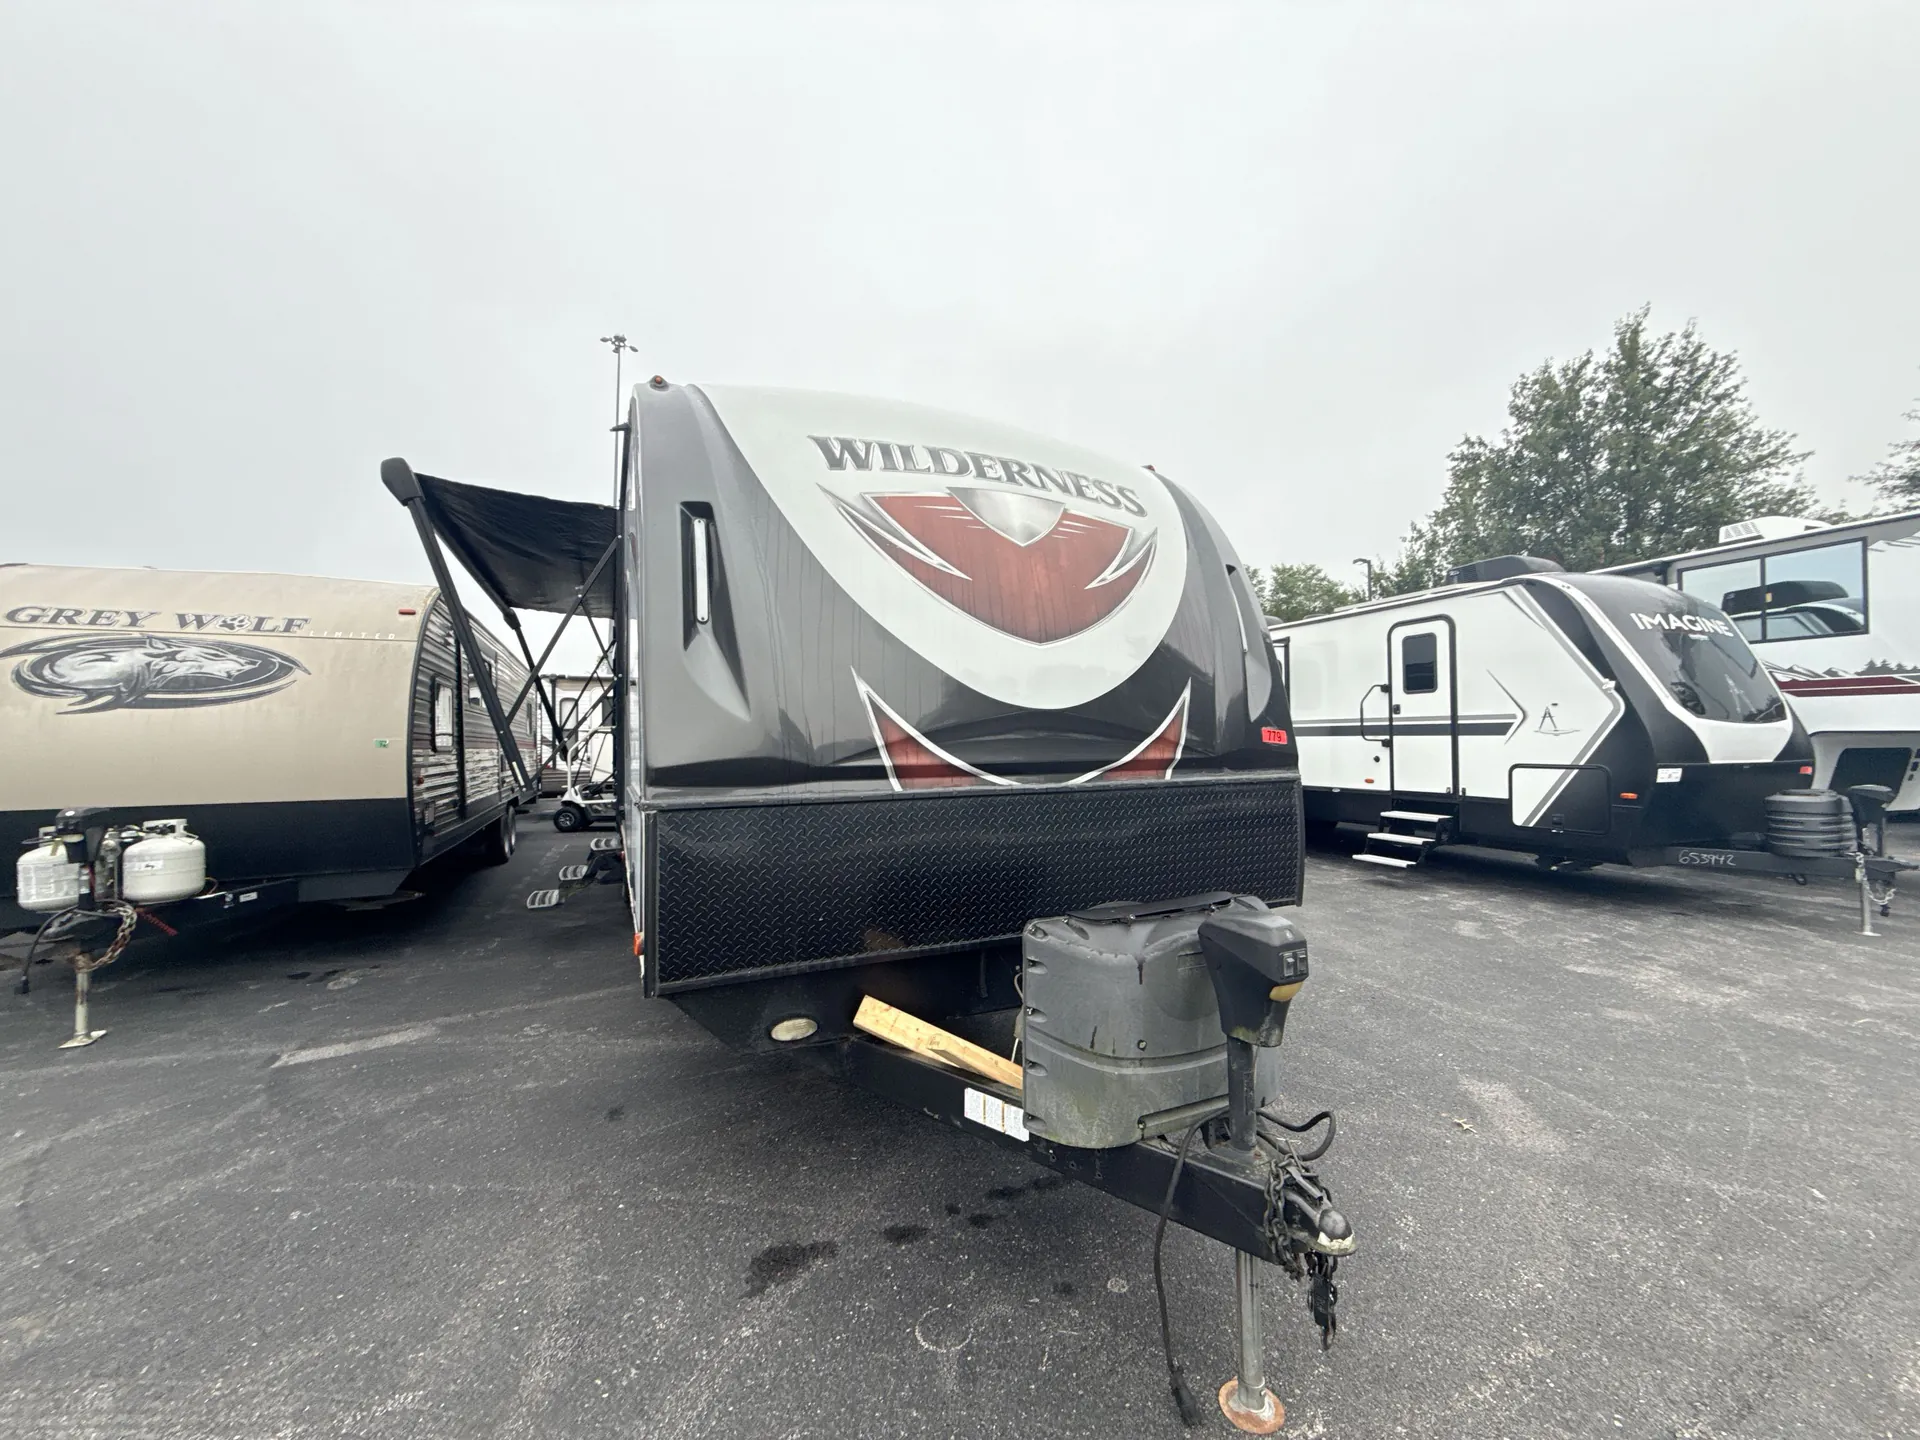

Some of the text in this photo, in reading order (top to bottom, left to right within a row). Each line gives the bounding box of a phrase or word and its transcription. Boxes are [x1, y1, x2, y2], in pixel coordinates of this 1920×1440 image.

[807, 435, 1147, 517] WILDERNESS
[4, 605, 161, 628] GREY
[1630, 613, 1734, 637] IMAGINE
[309, 630, 395, 640] LIMITED
[1267, 730, 1282, 742] 779
[1679, 850, 1736, 866] 653942
